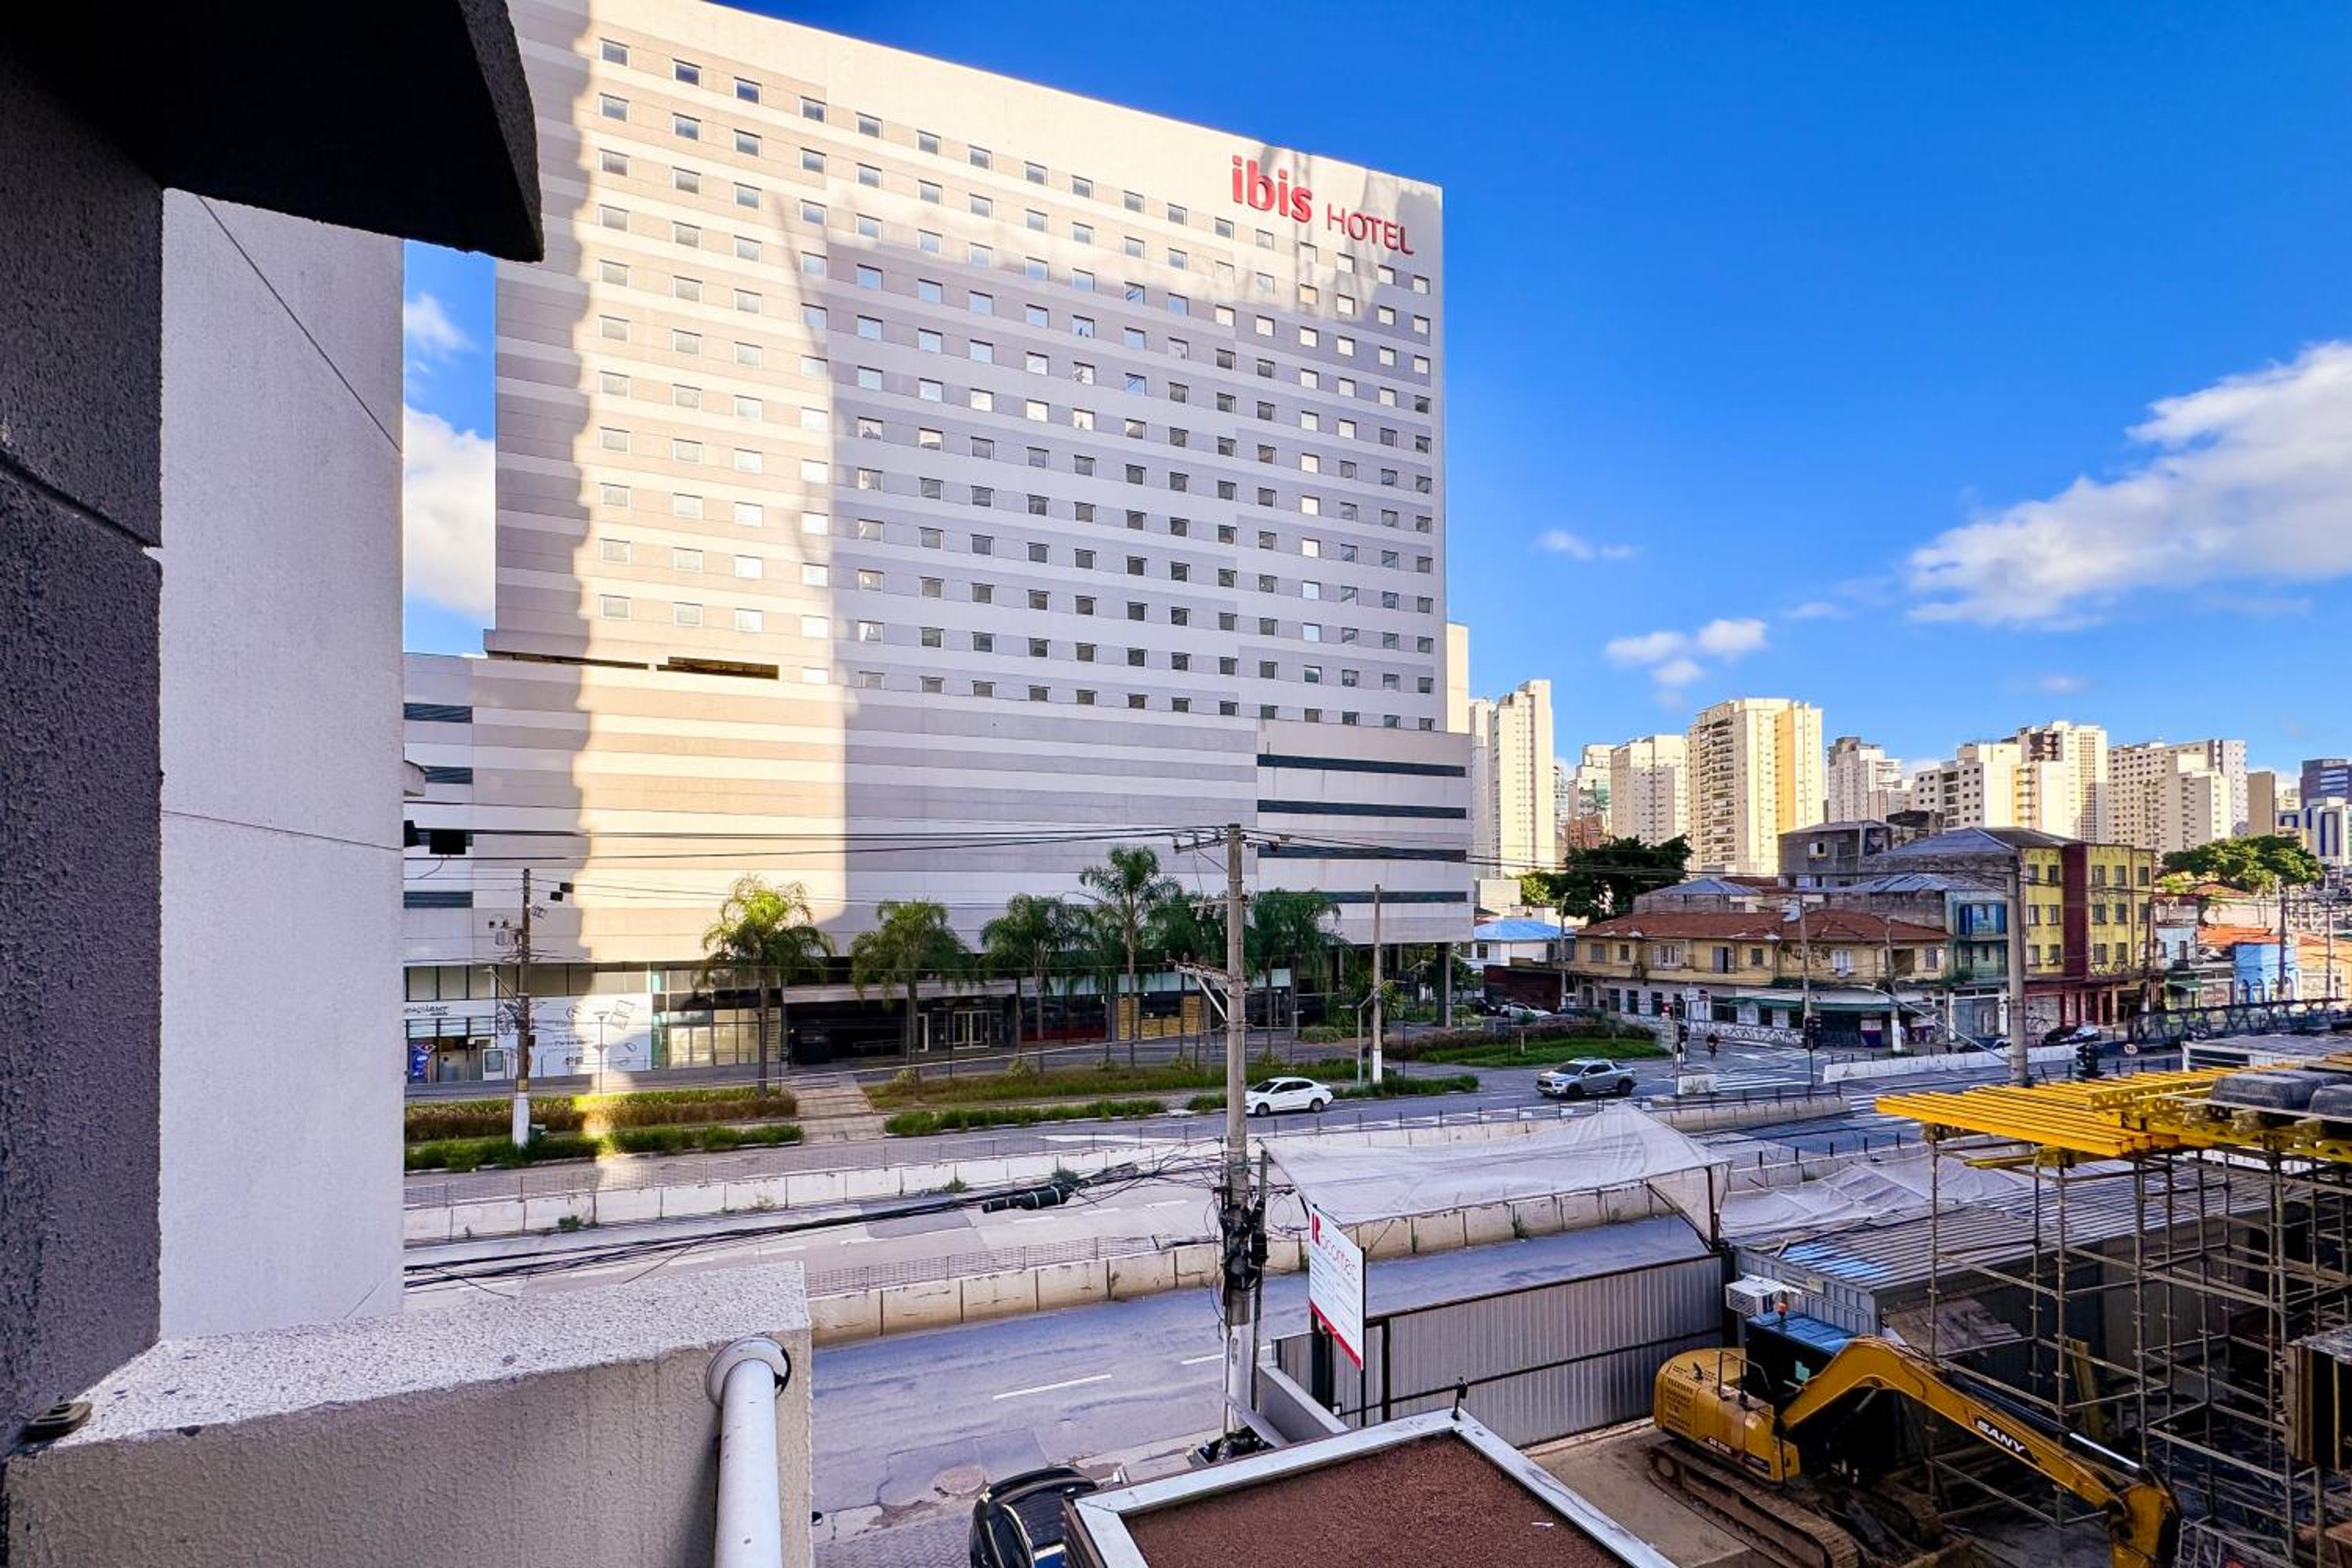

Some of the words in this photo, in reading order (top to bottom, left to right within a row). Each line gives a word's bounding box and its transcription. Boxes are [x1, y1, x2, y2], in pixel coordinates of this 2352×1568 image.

[1232, 155, 1313, 223] ibis
[1327, 203, 1415, 255] HOTEL
[1976, 1420, 2026, 1454] SANY
